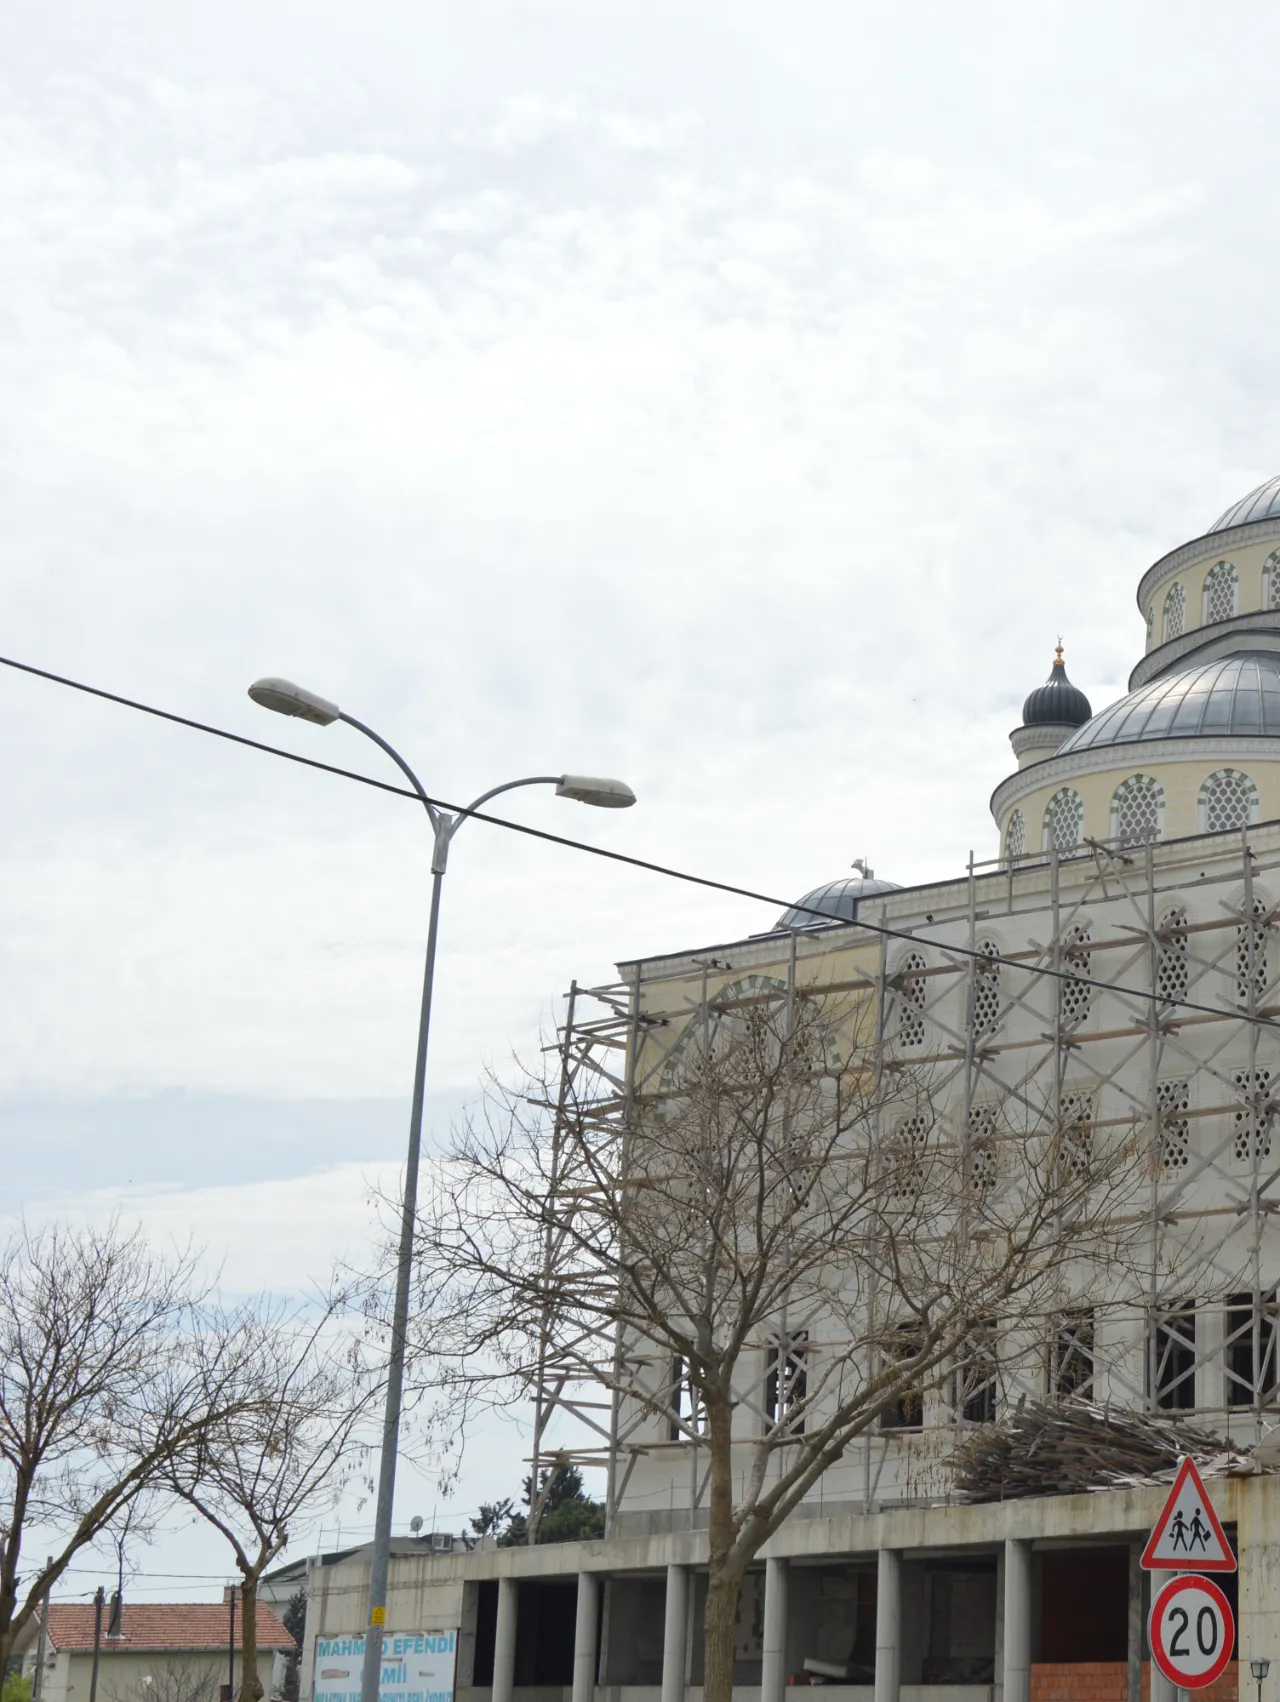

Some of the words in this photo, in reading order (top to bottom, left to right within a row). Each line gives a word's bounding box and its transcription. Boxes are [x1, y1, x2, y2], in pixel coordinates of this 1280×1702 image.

[318, 1638, 388, 1657] MAHMD
[394, 1631, 454, 1655] EFENDİ
[1168, 1606, 1218, 1657] 20
